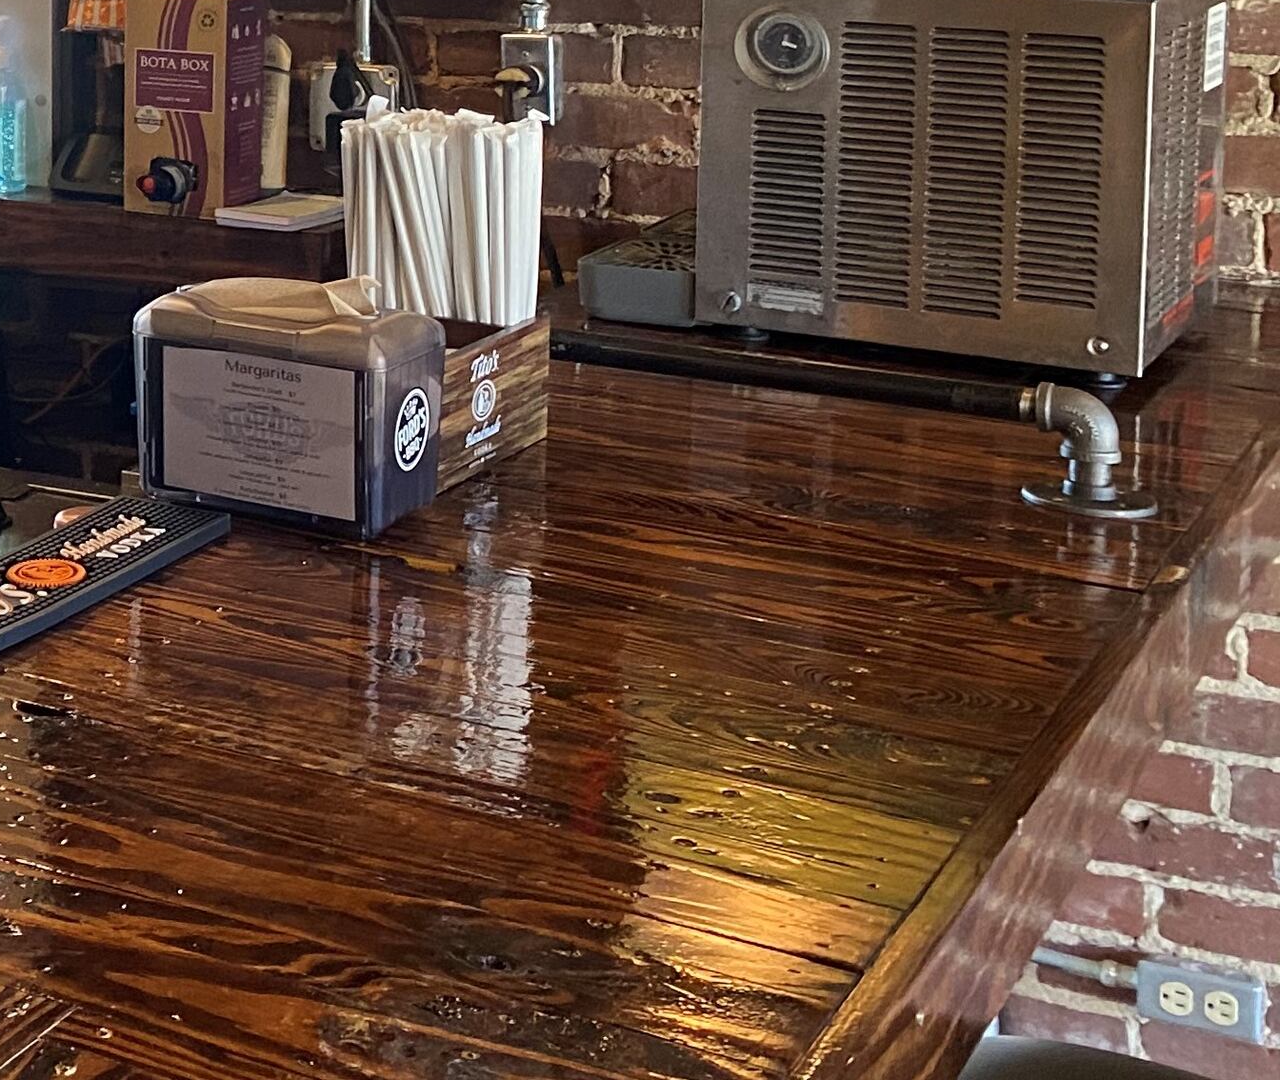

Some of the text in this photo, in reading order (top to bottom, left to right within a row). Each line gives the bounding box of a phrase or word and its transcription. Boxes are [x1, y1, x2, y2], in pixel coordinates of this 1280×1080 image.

[140, 55, 210, 72] BOTA BOX
[224, 358, 302, 384] Margaritas
[397, 405, 427, 452] FORD'S
[59, 513, 147, 562] Handmade
[95, 526, 167, 560] VODKA
